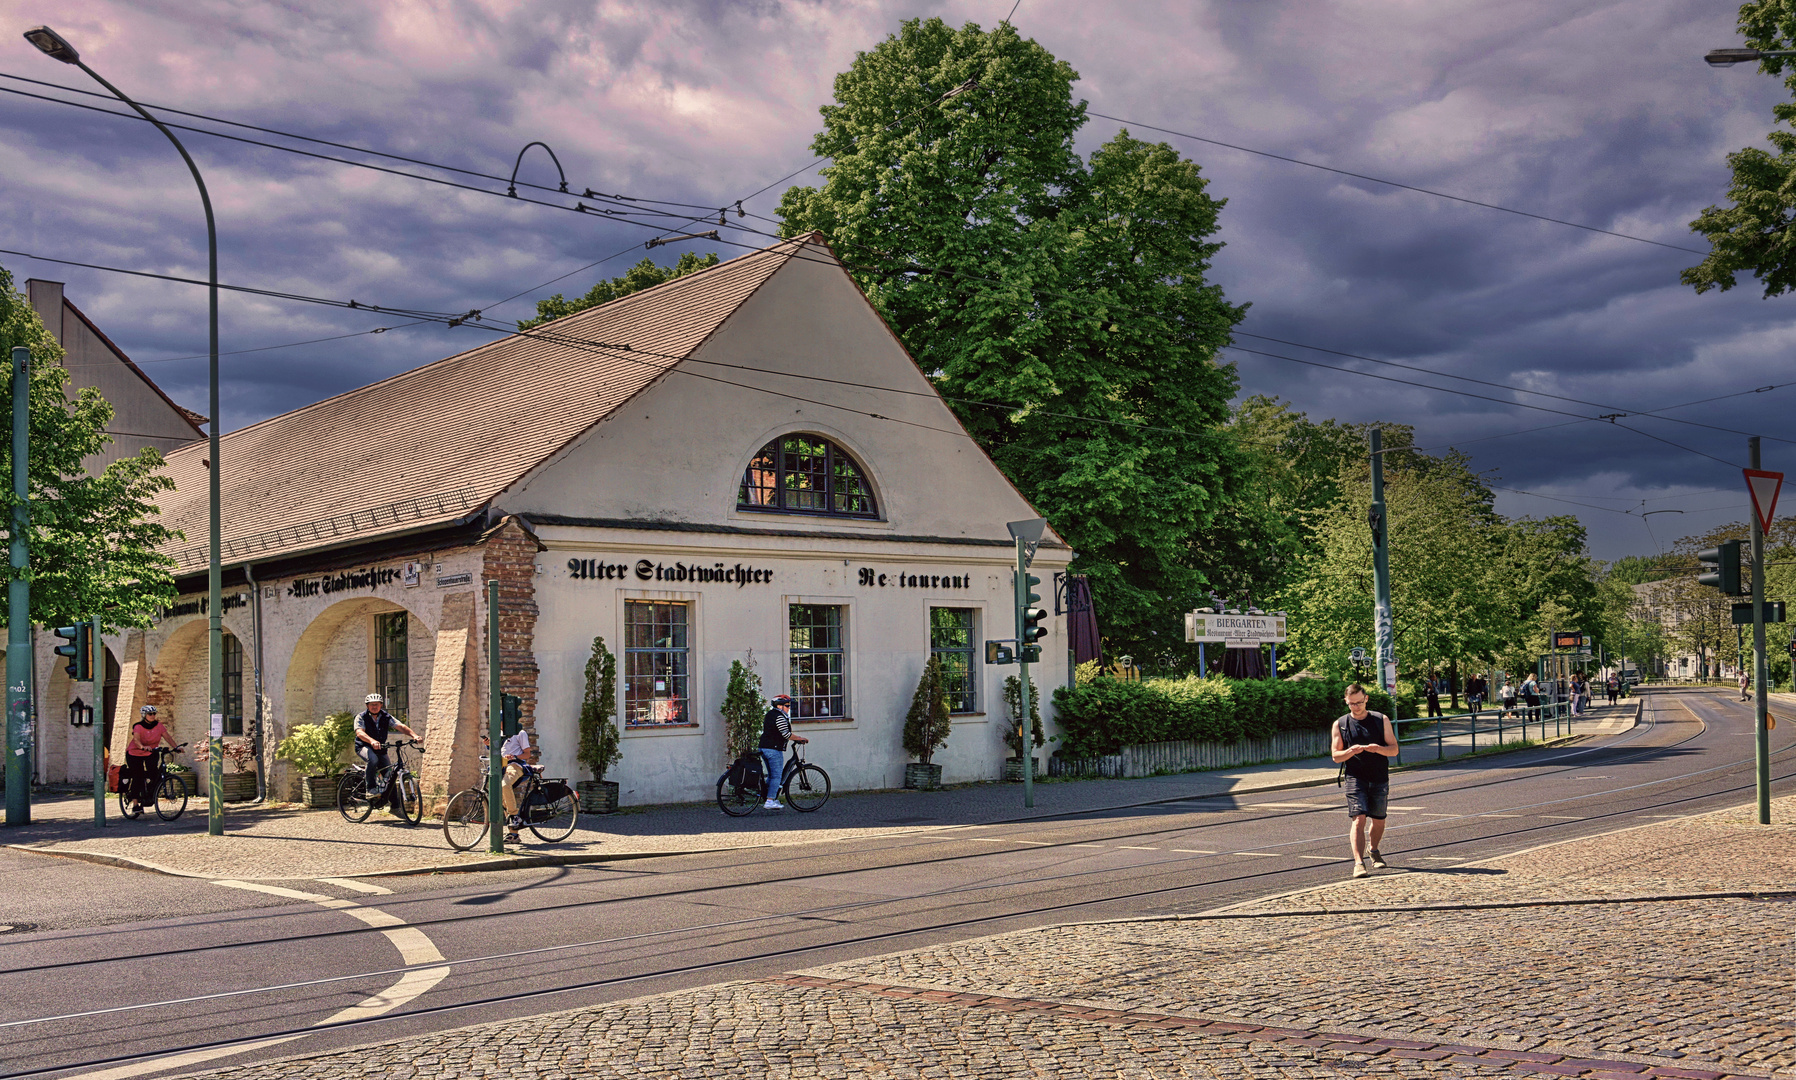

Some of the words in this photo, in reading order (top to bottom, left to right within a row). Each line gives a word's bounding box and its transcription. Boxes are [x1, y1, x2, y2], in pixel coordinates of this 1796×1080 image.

[567, 557, 629, 580] Alter
[635, 558, 774, 589] Stadtwächter
[1216, 618, 1267, 629] BIERGARTEN
[1207, 628, 1233, 637] Restaurant
